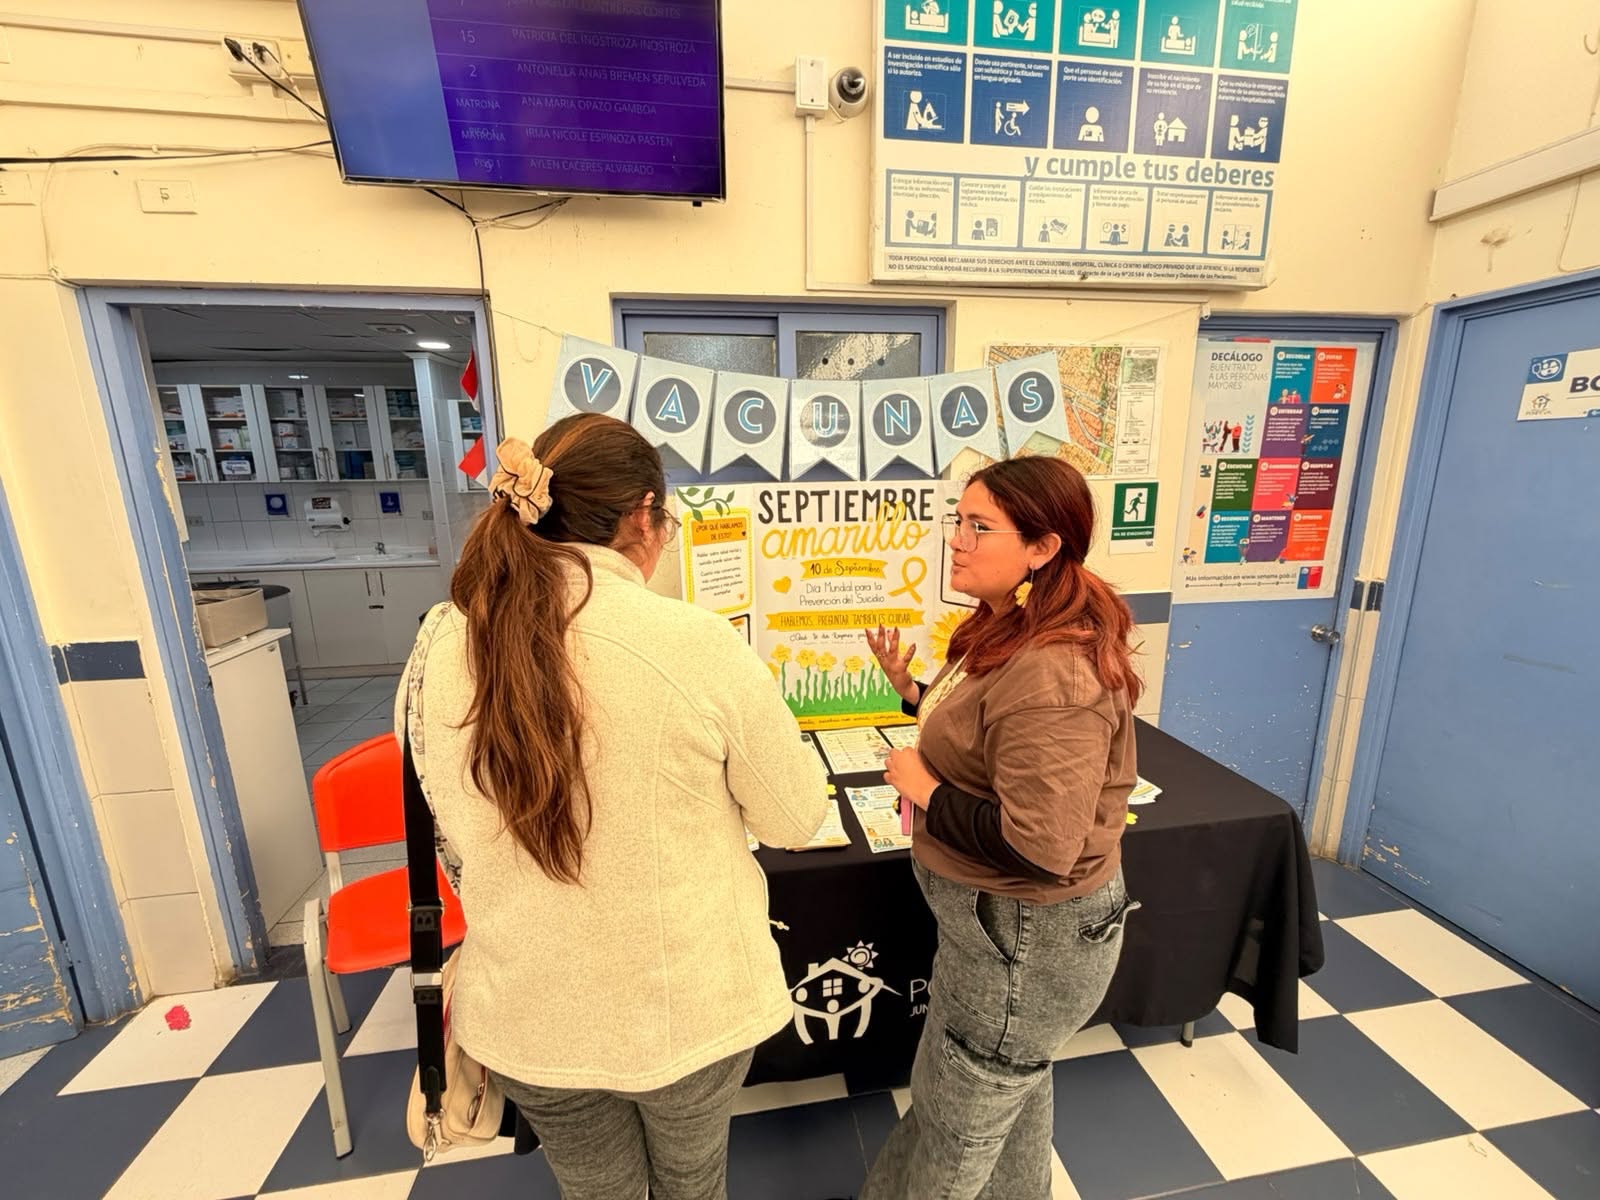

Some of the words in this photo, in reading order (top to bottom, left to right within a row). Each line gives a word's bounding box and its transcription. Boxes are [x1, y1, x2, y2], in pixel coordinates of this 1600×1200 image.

[461, 29, 476, 44] 15
[511, 29, 557, 43] PATRICIA
[470, 64, 478, 78] 2
[517, 64, 577, 78] ANTONELLA
[652, 74, 706, 88] SEPULVEDA
[1064, 66, 1074, 74] Que
[456, 97, 501, 110] MATRONA
[520, 96, 543, 107] ANA
[544, 97, 577, 110] MARIA
[578, 99, 612, 112] OPAZO
[614, 101, 657, 115] GAMBOA
[552, 130, 588, 141] NICOLE
[590, 132, 637, 145] ESPINOZA
[605, 163, 655, 176] ALVARADO
[1025, 156, 1040, 179] y
[1046, 155, 1137, 182] cumple
[1143, 159, 1179, 182] tus
[1186, 160, 1275, 188] deberes
[1211, 350, 1263, 362] DECÁLOGO
[1231, 363, 1257, 372] TRATO
[1208, 372, 1214, 381] A
[1230, 373, 1268, 381] PERSONAS
[581, 361, 1043, 438] VACUNAS
[758, 488, 935, 525] SEPTIEMBRE
[761, 502, 931, 560] amarillo
[810, 563, 821, 576] 10
[824, 564, 833, 574] de
[834, 560, 881, 577] Septiembre
[825, 581, 853, 593] Mundial
[855, 585, 872, 595] para
[874, 581, 882, 591] la
[842, 594, 853, 605] del
[856, 593, 885, 604] Suicidio
[910, 978, 933, 1003] P
